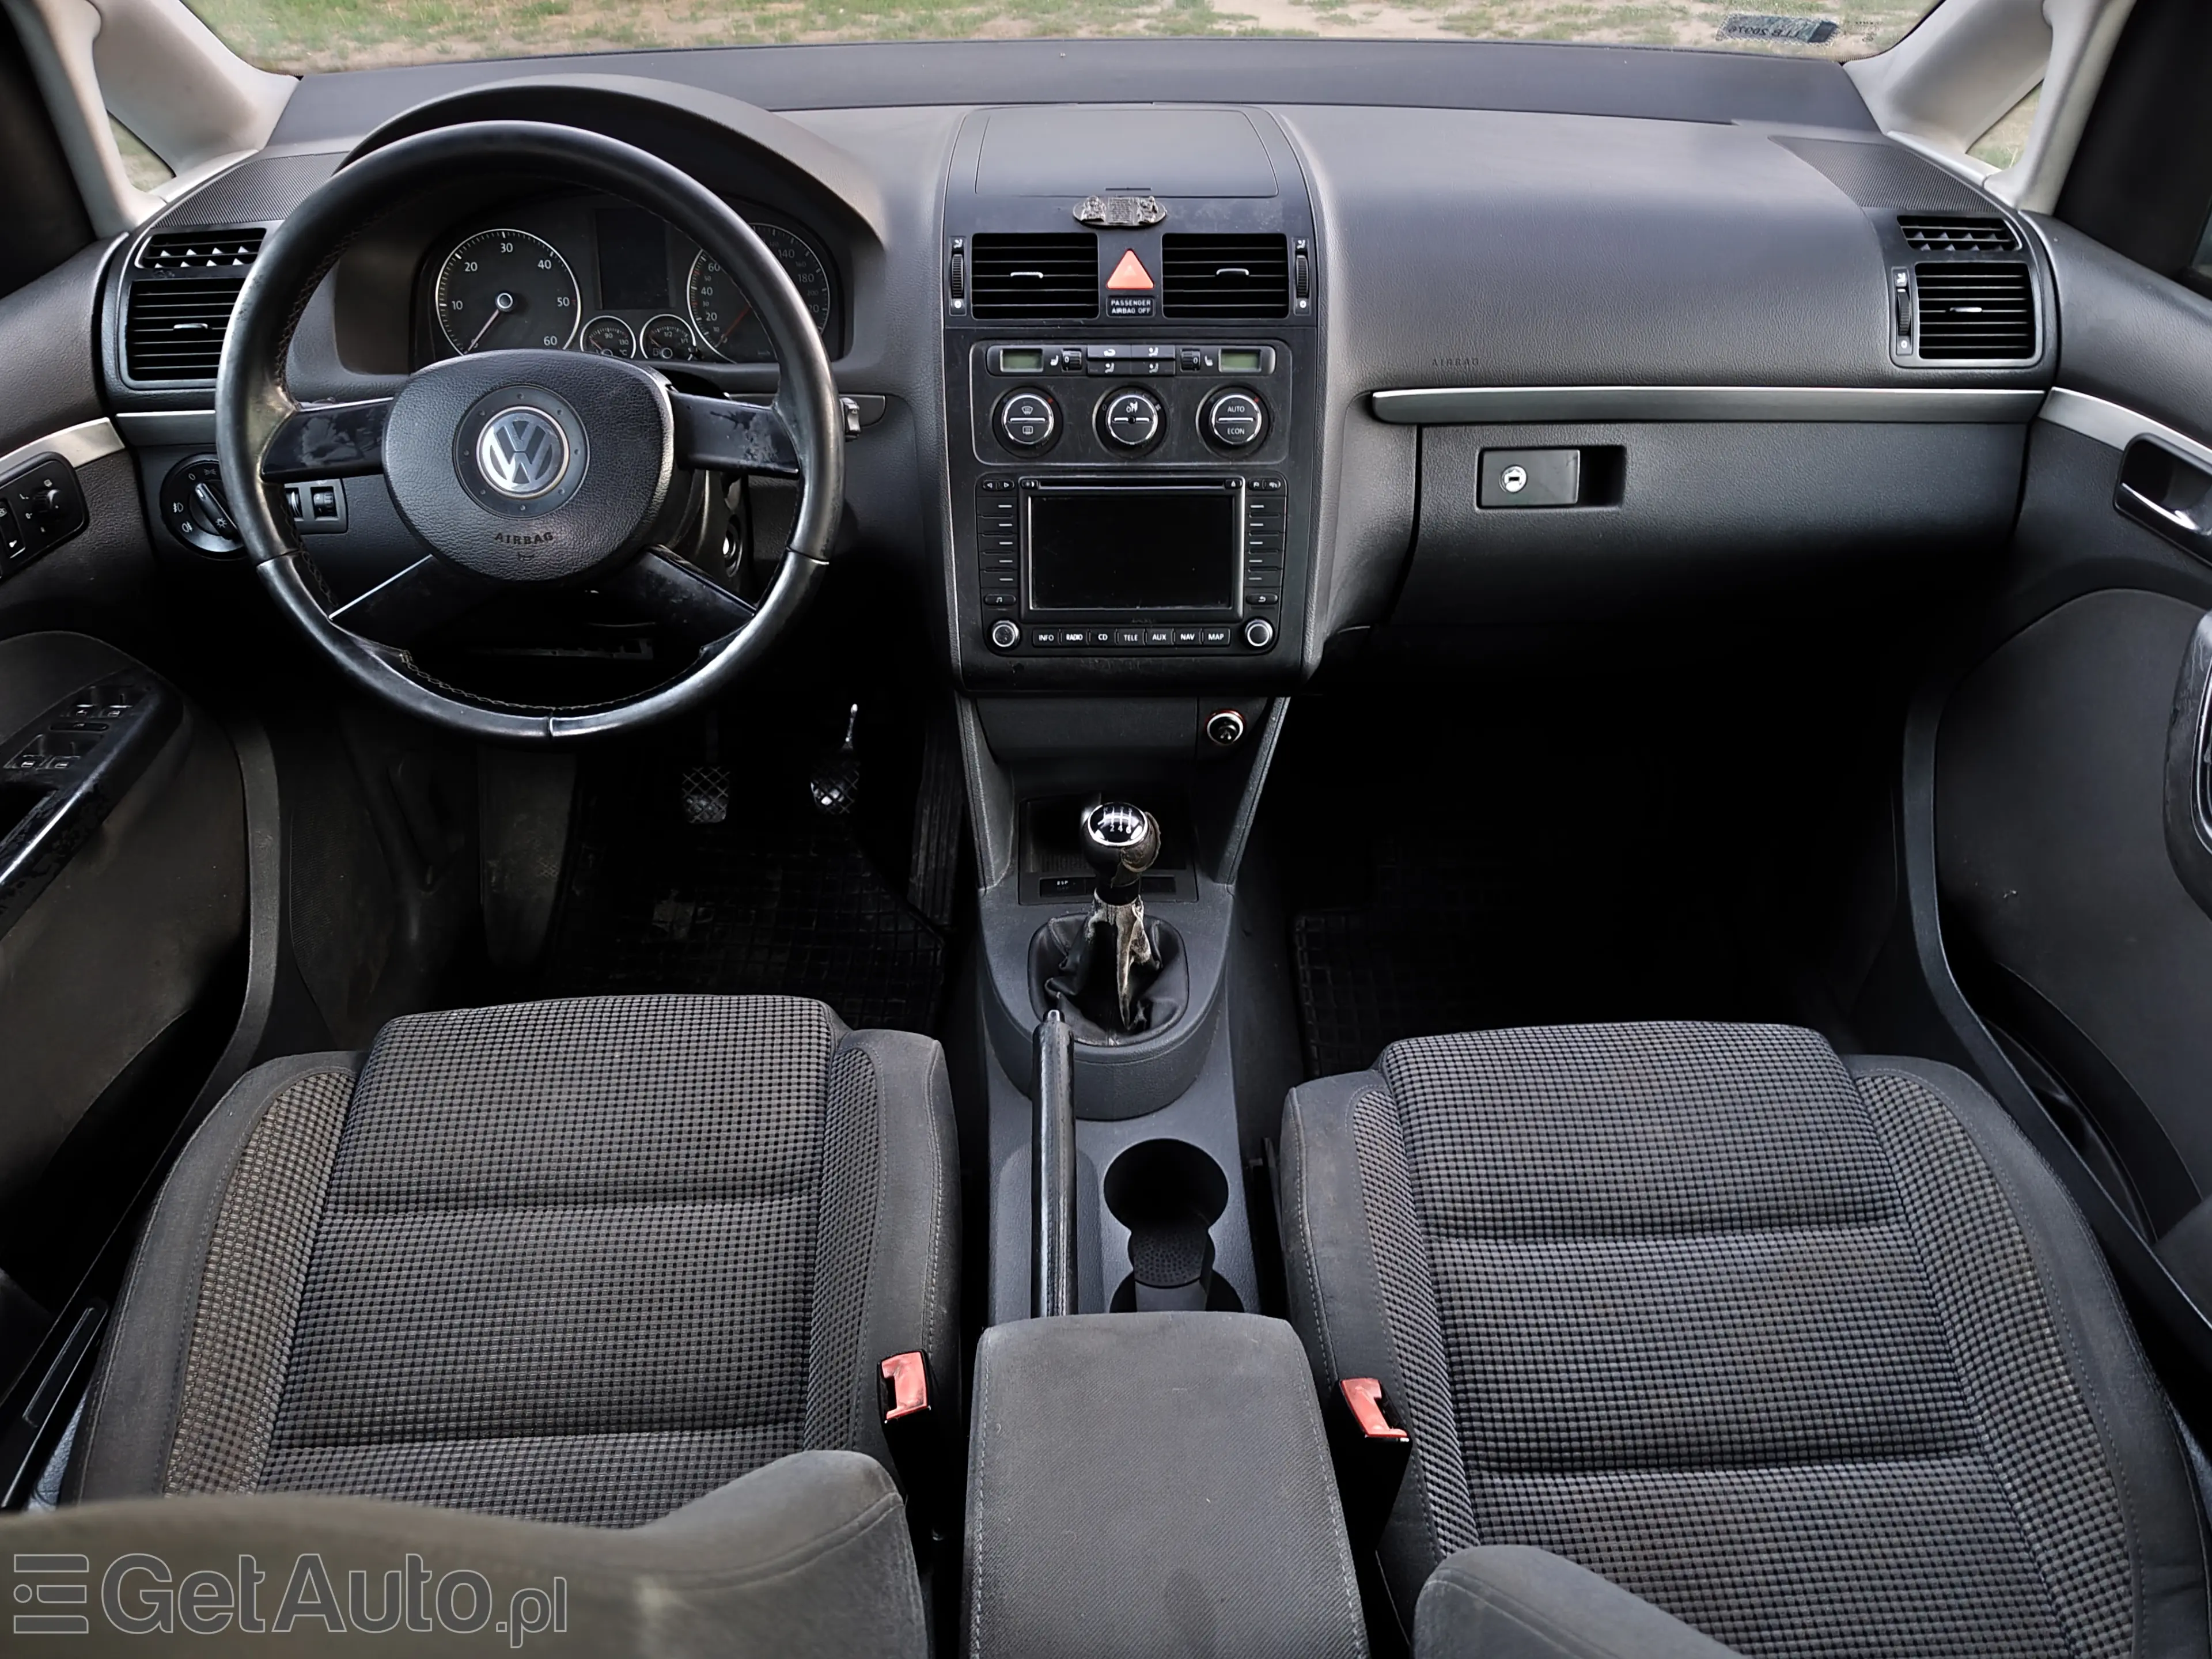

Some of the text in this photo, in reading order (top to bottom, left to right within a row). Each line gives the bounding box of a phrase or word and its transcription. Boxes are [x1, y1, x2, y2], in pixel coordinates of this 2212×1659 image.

[501, 243, 513, 253] 30
[778, 249, 795, 259] 140
[464, 262, 478, 272] 20
[537, 259, 552, 270] 40
[708, 263, 721, 272] 60
[798, 274, 815, 283] 180
[701, 286, 713, 296] 40
[452, 300, 463, 310] 10
[557, 297, 570, 306] 50
[706, 312, 717, 321] 20
[543, 336, 558, 346] 60
[494, 532, 554, 545] AIRBAG
[1110, 824, 1115, 832] 2
